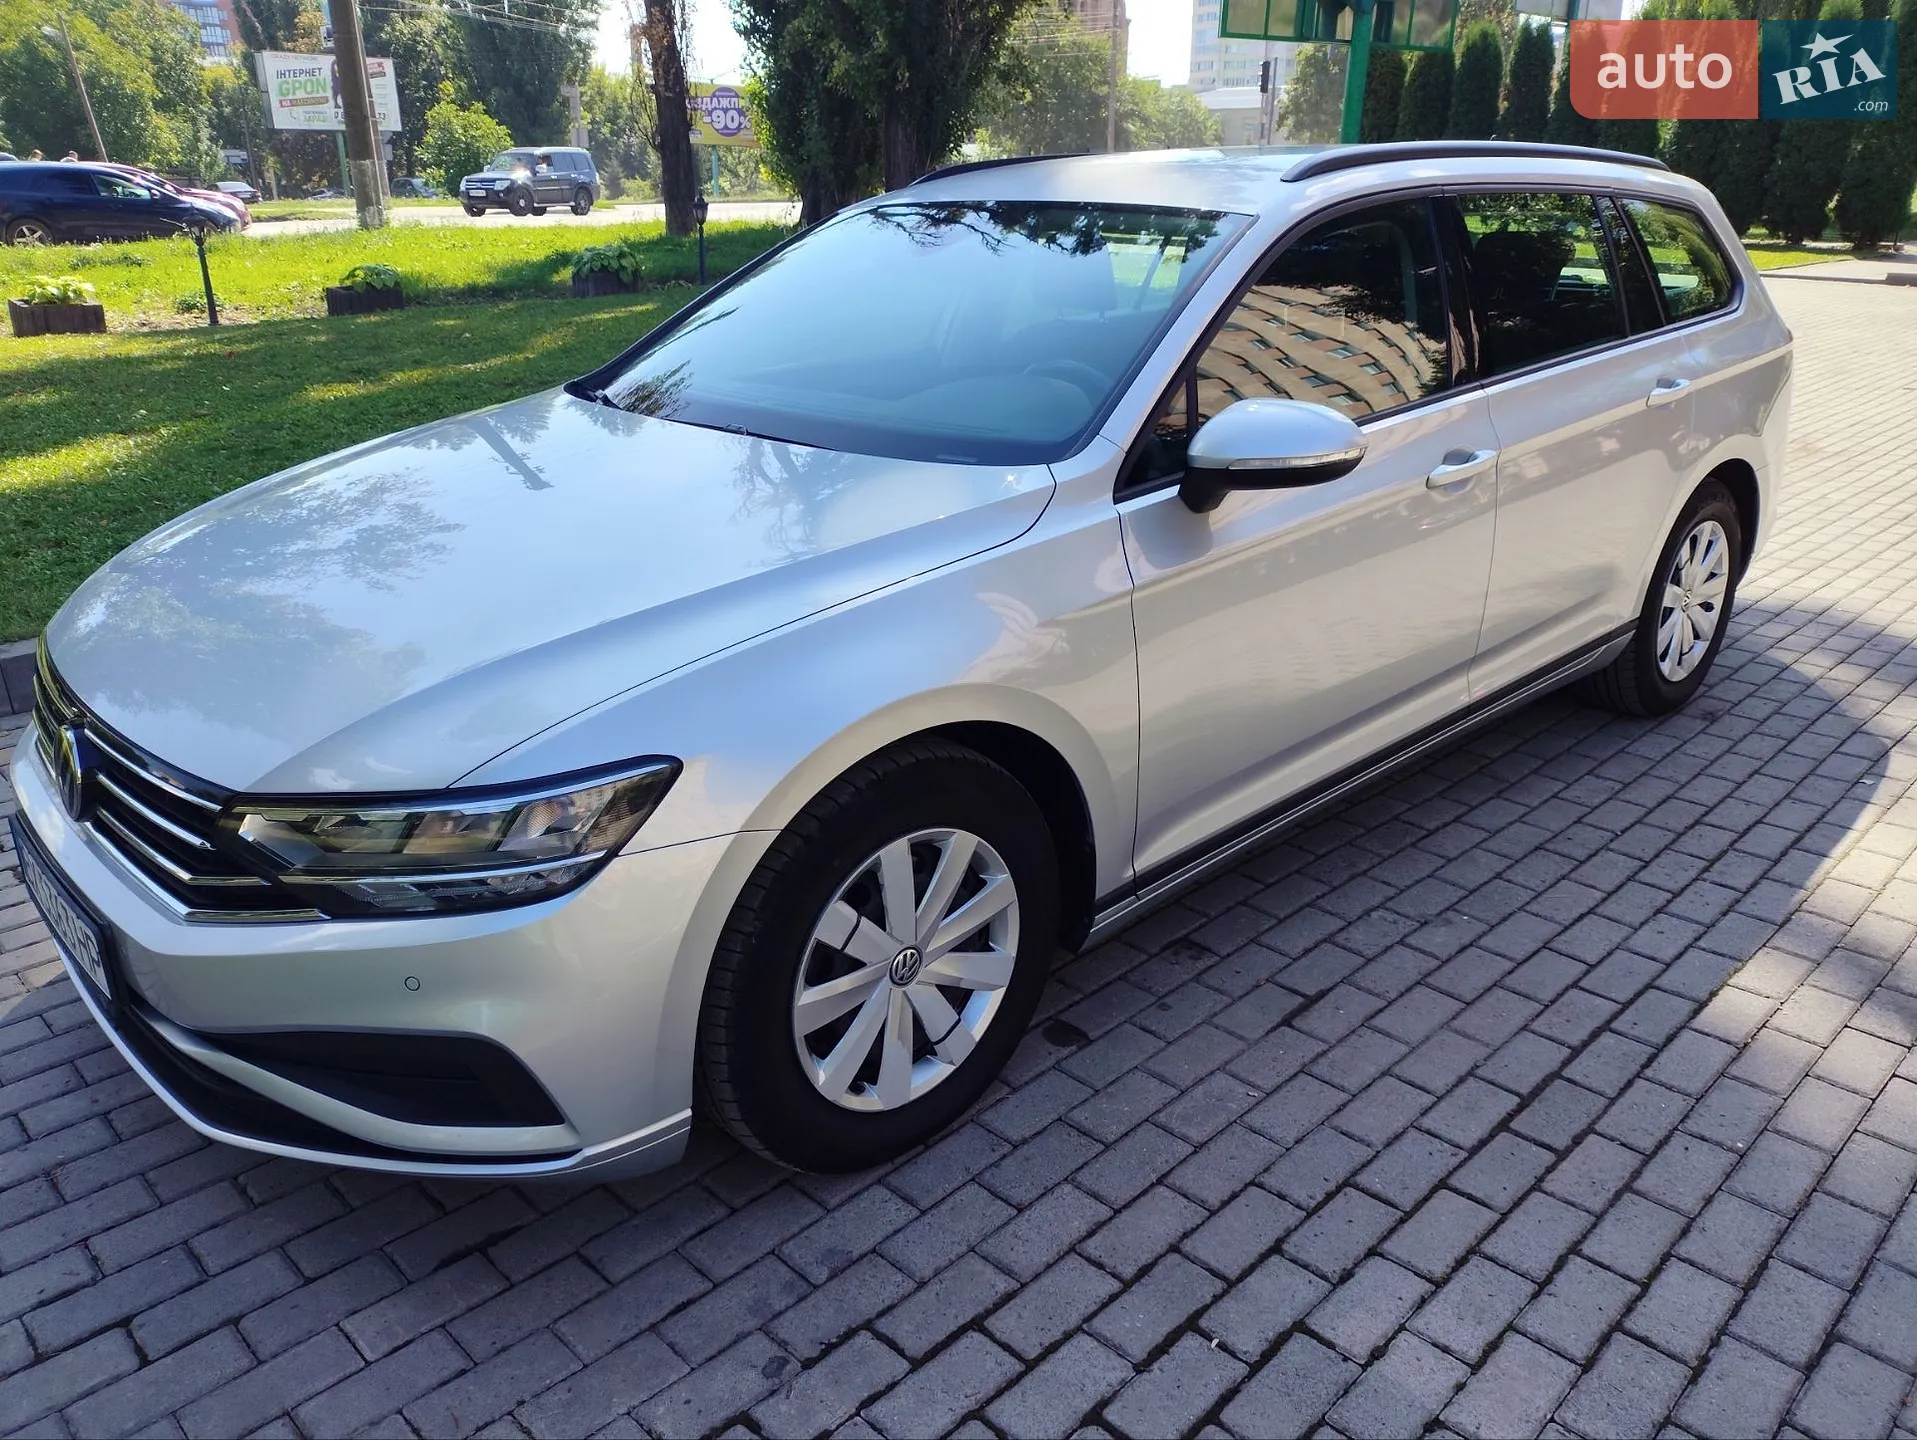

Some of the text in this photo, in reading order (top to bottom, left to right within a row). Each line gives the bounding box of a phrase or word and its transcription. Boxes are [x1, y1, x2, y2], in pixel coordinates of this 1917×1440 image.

[276, 67, 323, 79] ІНТЕРНЕТ
[278, 78, 327, 97] GPON
[703, 109, 751, 129] -90%
